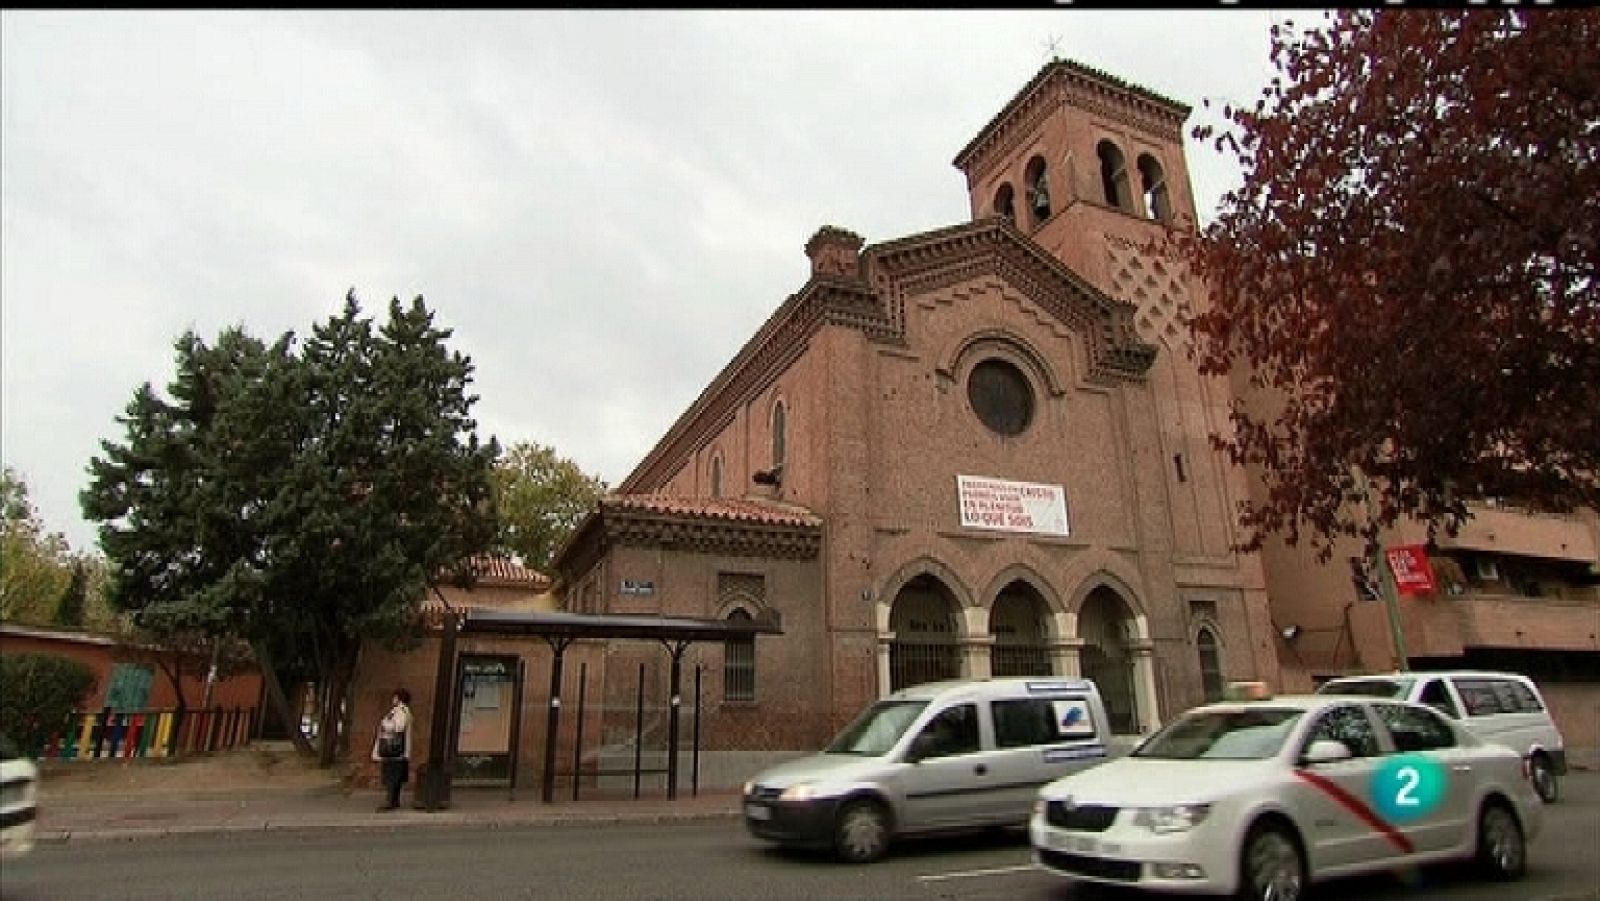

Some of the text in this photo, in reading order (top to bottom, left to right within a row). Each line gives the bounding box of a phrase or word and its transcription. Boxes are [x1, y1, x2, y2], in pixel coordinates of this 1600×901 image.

[964, 512, 1034, 528] LO QUE SOIS
